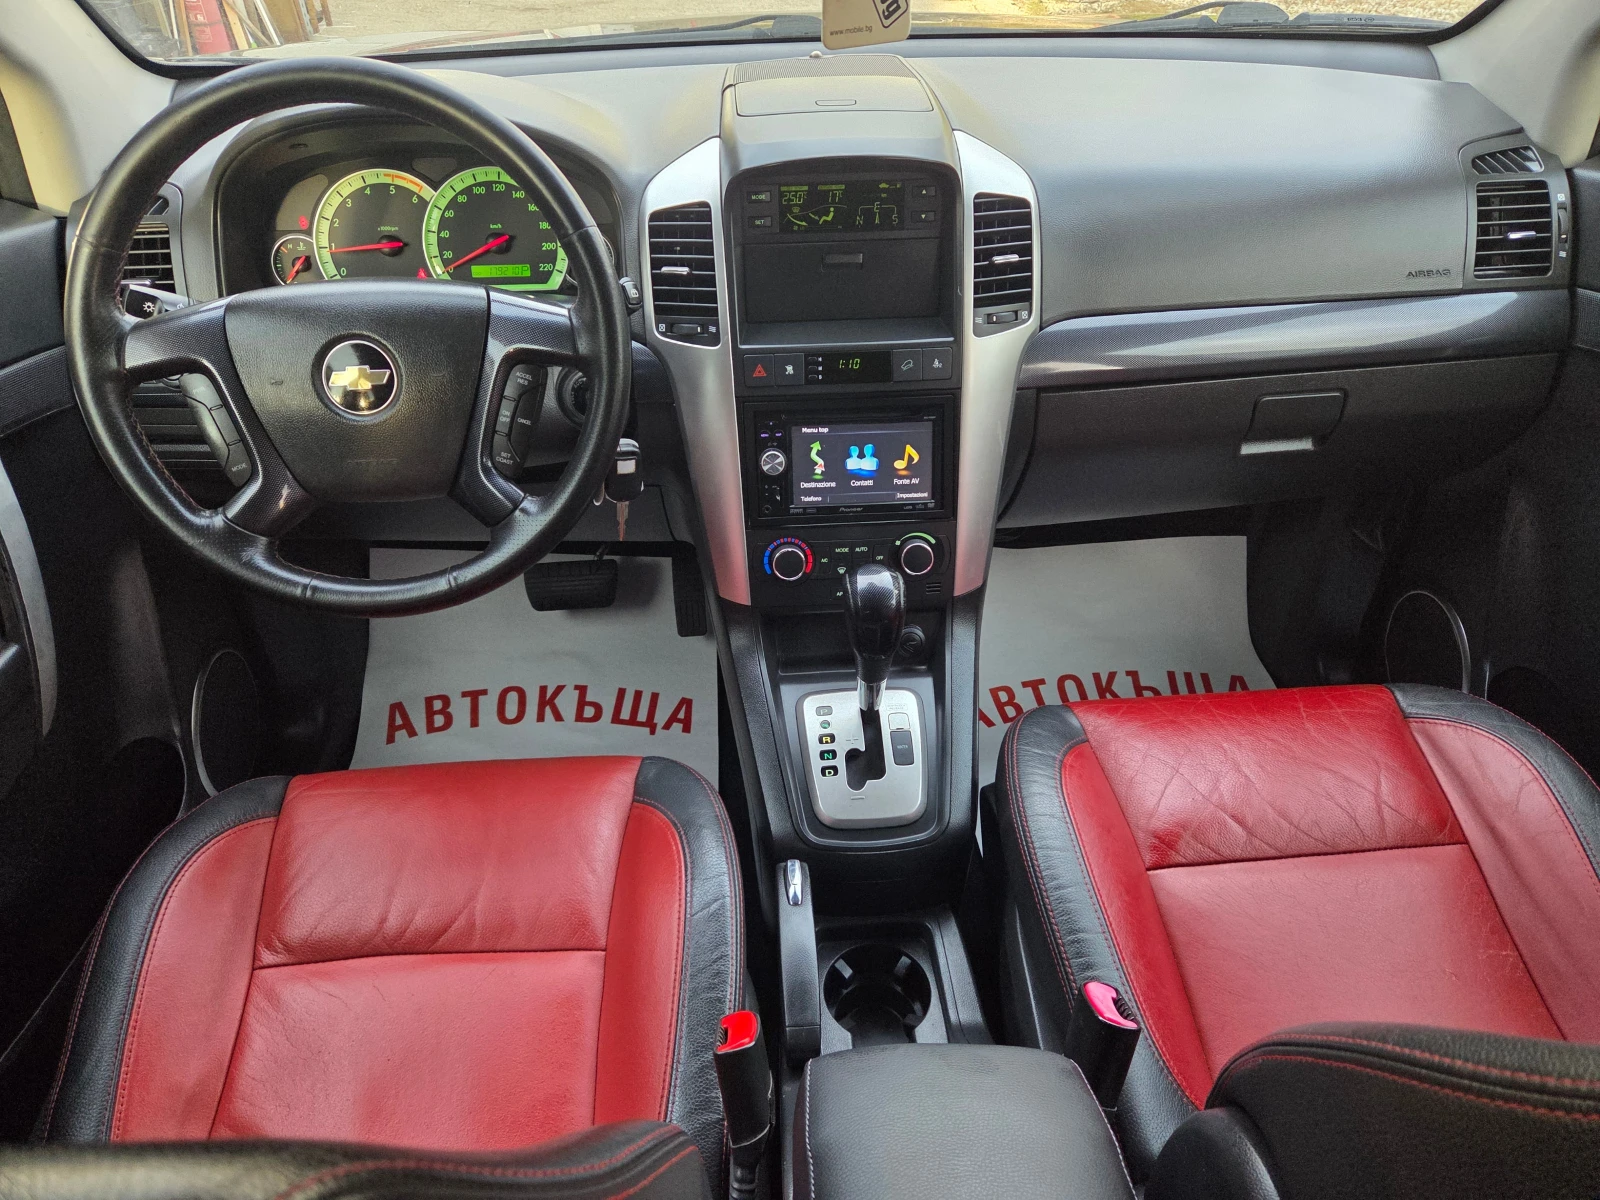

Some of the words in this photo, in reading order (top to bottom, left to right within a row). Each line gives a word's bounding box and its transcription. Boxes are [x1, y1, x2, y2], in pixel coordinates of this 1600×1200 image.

[829, 25, 873, 36] www.mobile.bg
[364, 186, 371, 195] 4
[389, 185, 396, 194] 5
[472, 186, 486, 194] 100
[492, 183, 506, 192] 120
[411, 194, 418, 203] 6
[457, 194, 467, 202] 80
[512, 190, 525, 199] 140
[345, 198, 352, 207] 3
[444, 209, 454, 218] 60
[333, 218, 340, 227] 2
[439, 230, 450, 238] 40
[541, 242, 556, 250] 200
[442, 250, 453, 258] 20
[340, 267, 347, 276] 0
[539, 263, 554, 271] 220
[1405, 269, 1452, 278] AIRBAG
[839, 358, 861, 369] 1:10
[516, 372, 532, 380] ACCEL
[818, 426, 829, 434] top
[231, 462, 248, 472] MODE
[850, 479, 874, 487] Contatti
[911, 477, 920, 485] AV
[386, 684, 694, 745] АВТОКЪЩА
[824, 752, 833, 760] N
[825, 769, 834, 777] D
